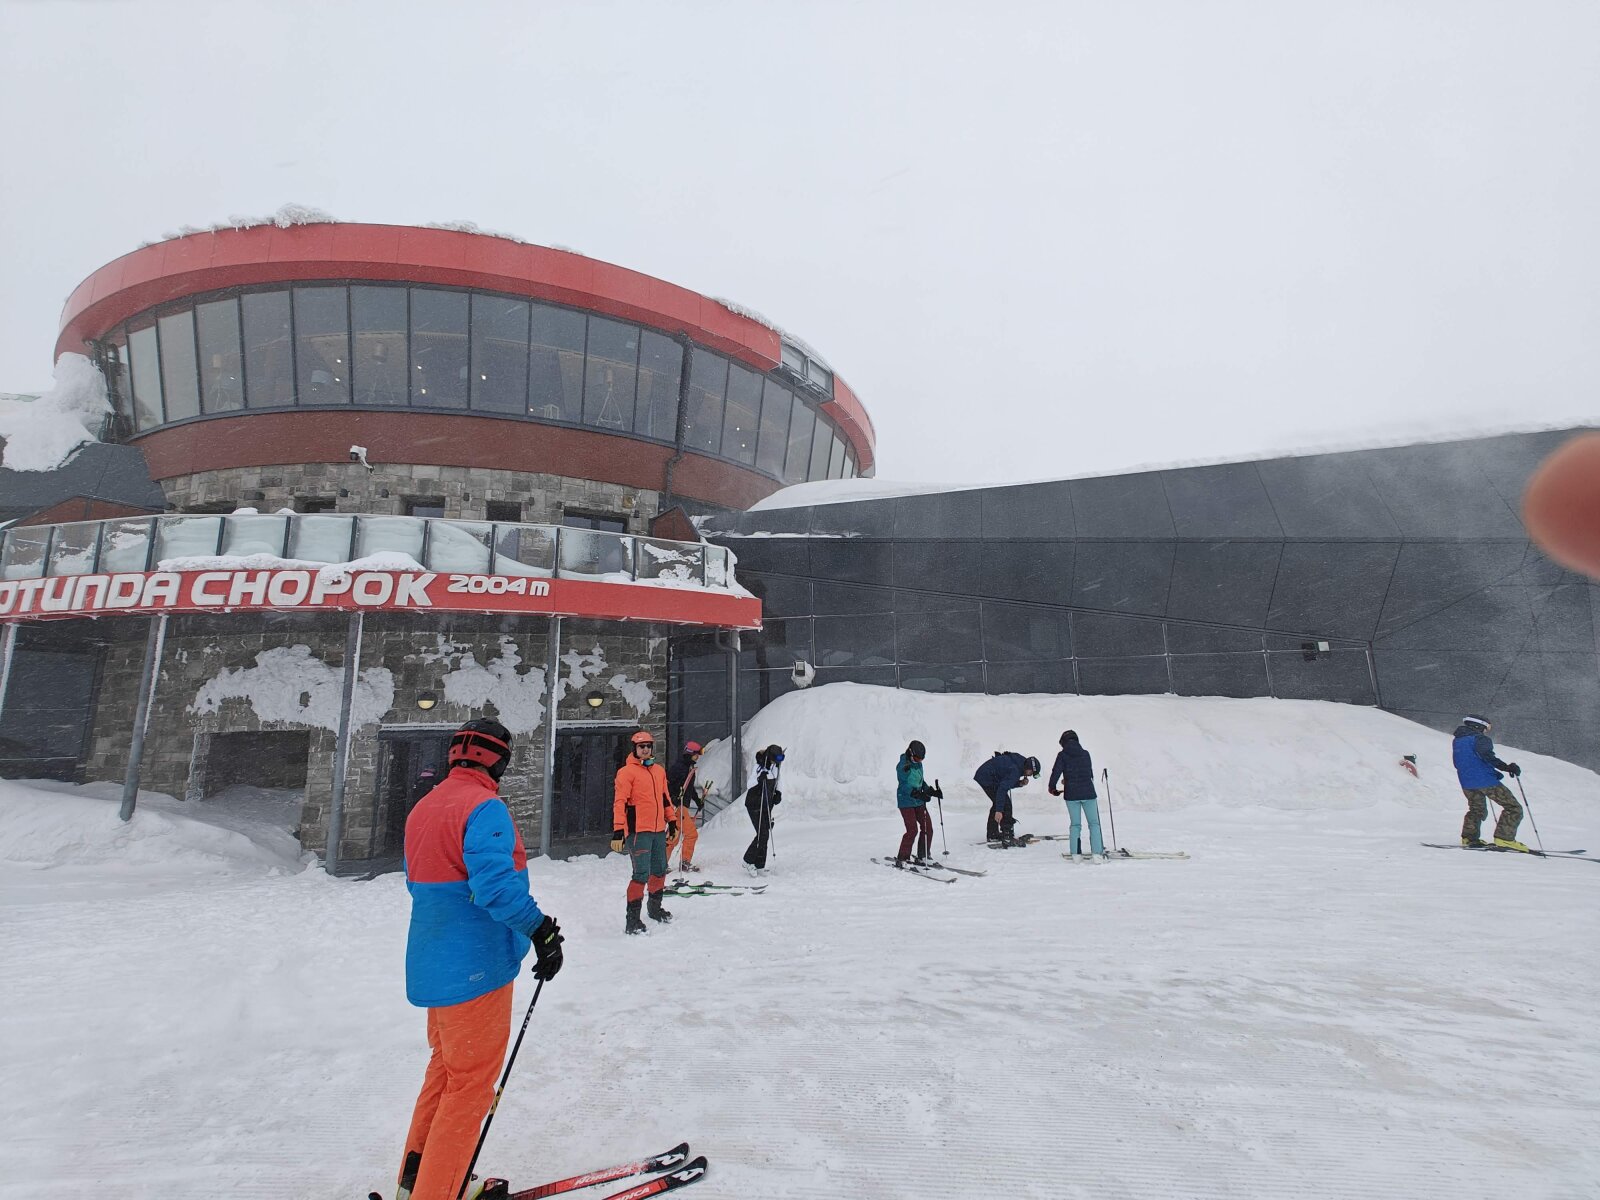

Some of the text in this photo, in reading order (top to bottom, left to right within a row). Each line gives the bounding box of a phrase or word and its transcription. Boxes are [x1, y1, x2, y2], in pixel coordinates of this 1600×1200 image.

[191, 571, 437, 606] CHOPOK
[447, 575, 527, 595] 2004
[529, 581, 550, 597] m
